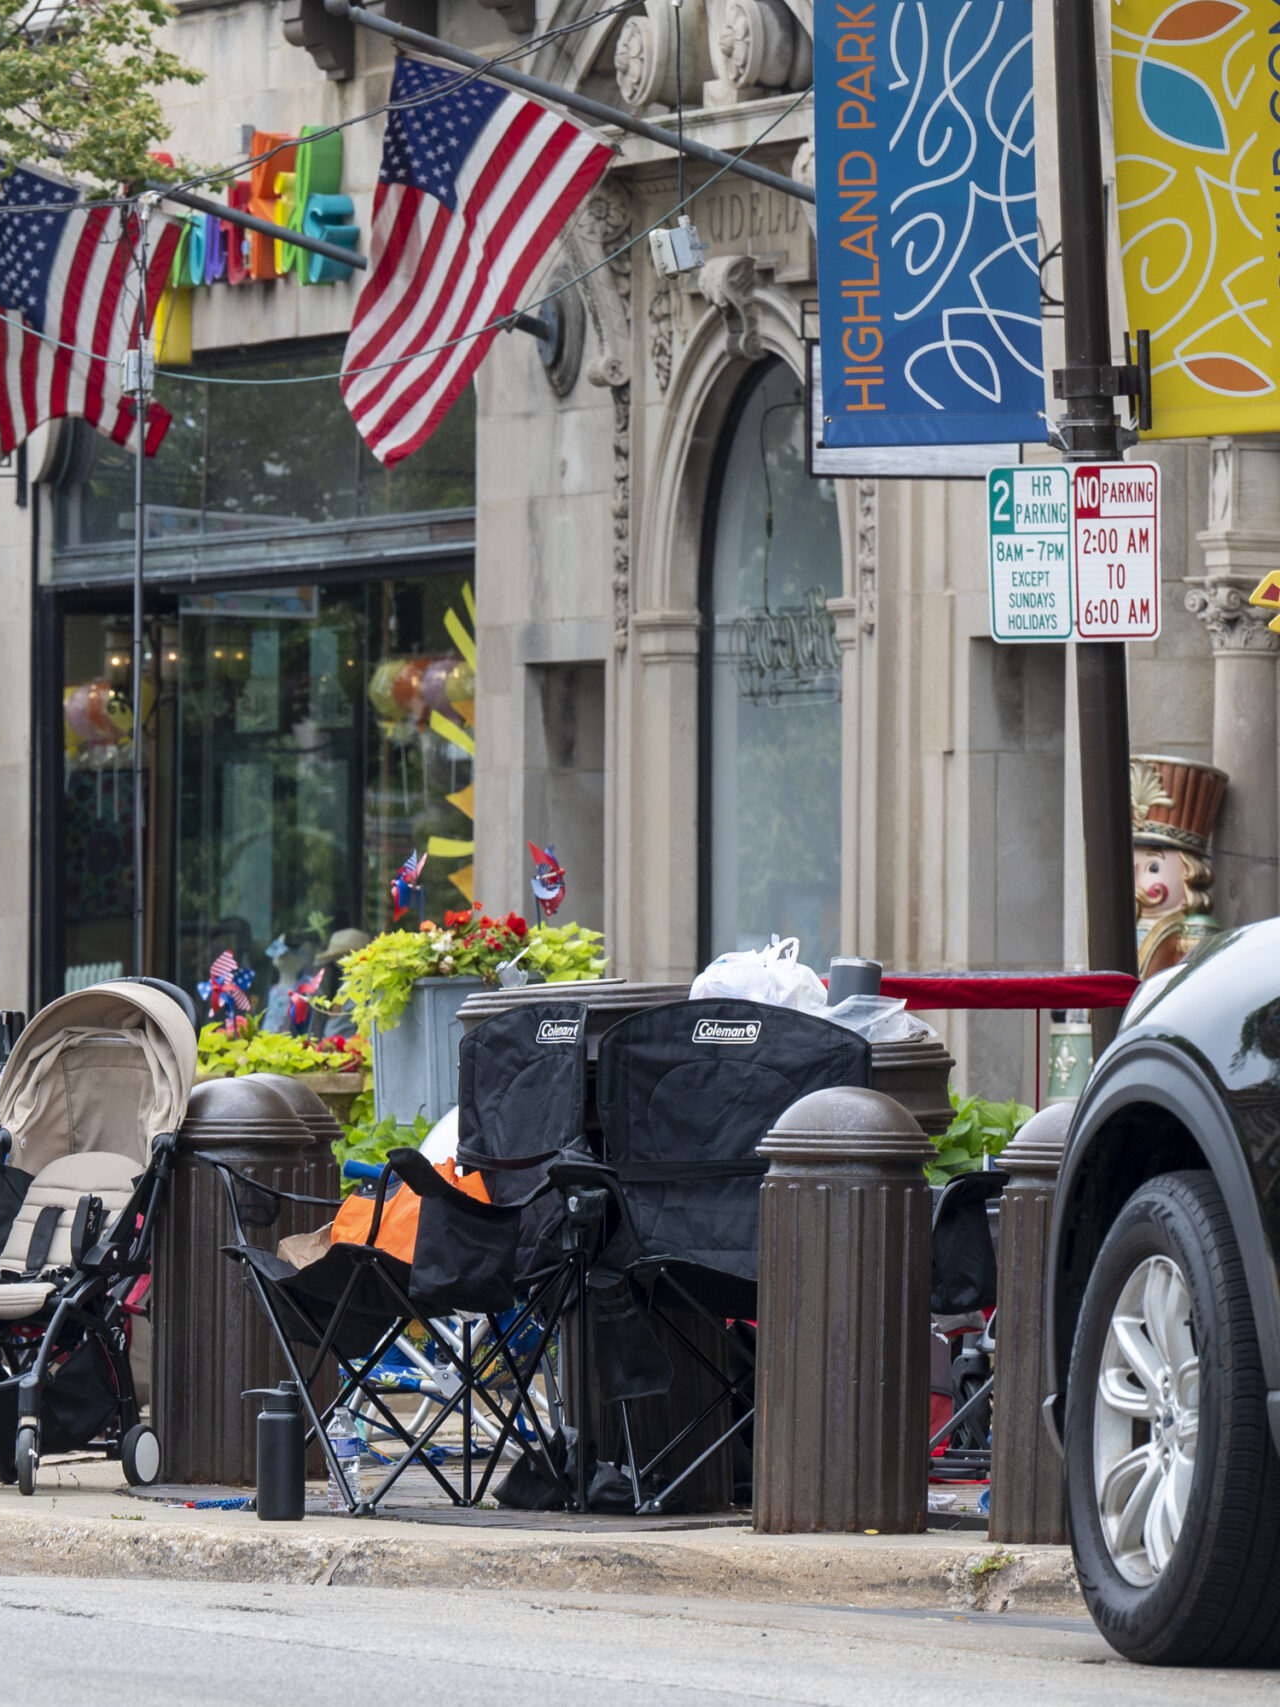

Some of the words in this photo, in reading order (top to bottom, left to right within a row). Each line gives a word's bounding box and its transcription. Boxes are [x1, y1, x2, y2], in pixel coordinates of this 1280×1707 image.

[836, 2, 876, 129] PARK
[838, 150, 886, 411] HIGHLAND
[993, 480, 1010, 521] 2
[1031, 475, 1052, 496] HR
[1077, 476, 1100, 509] NO
[1102, 482, 1153, 503] PARKING
[1016, 503, 1067, 524] PARKING
[1083, 528, 1118, 554] 2:00
[1128, 528, 1149, 554] AM
[1012, 571, 1050, 587] EXCEPT
[1107, 564, 1125, 590] TO
[1009, 593, 1055, 608] SUNDAYS
[1085, 599, 1119, 625] 6:00
[1128, 598, 1150, 624] AM
[1008, 614, 1057, 630] HOLIDAYS
[699, 1022, 745, 1037] Coleman
